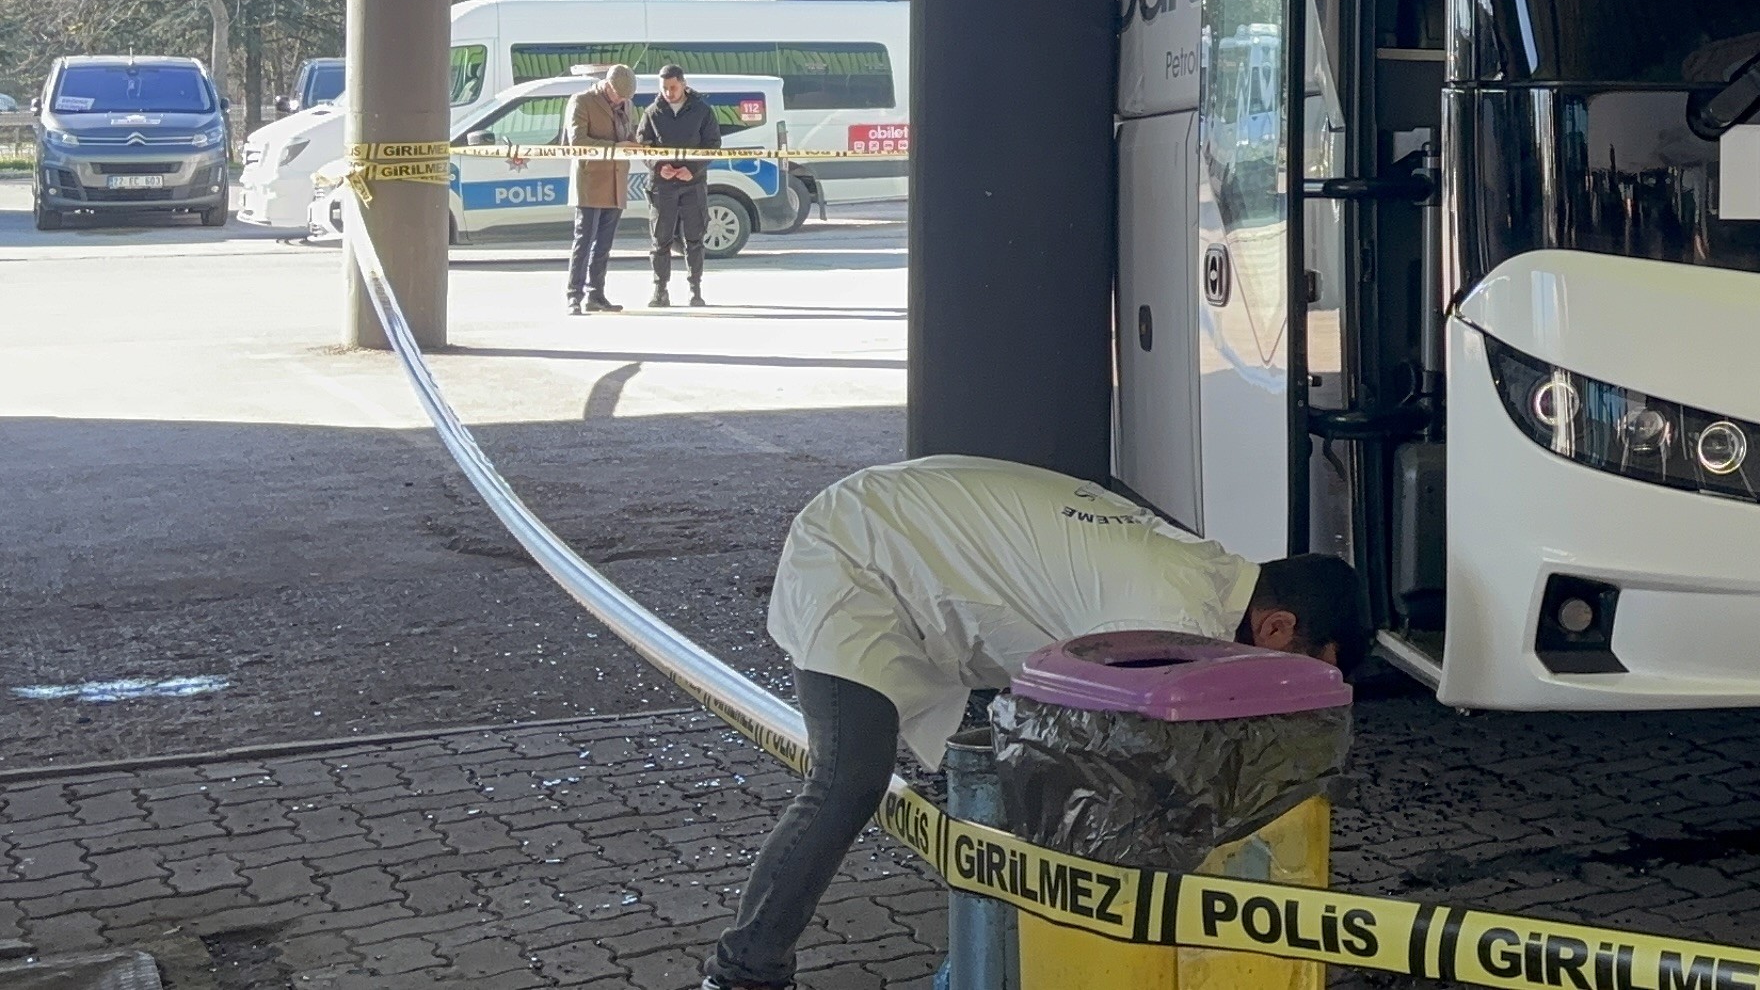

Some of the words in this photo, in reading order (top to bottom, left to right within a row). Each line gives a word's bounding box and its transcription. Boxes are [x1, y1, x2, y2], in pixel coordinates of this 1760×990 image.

[1166, 43, 1200, 80] Petrol
[743, 102, 760, 113] 112
[495, 181, 556, 204] POLİS
[954, 834, 1124, 927] GİRİLMEZ
[1201, 889, 1379, 957] POLİS
